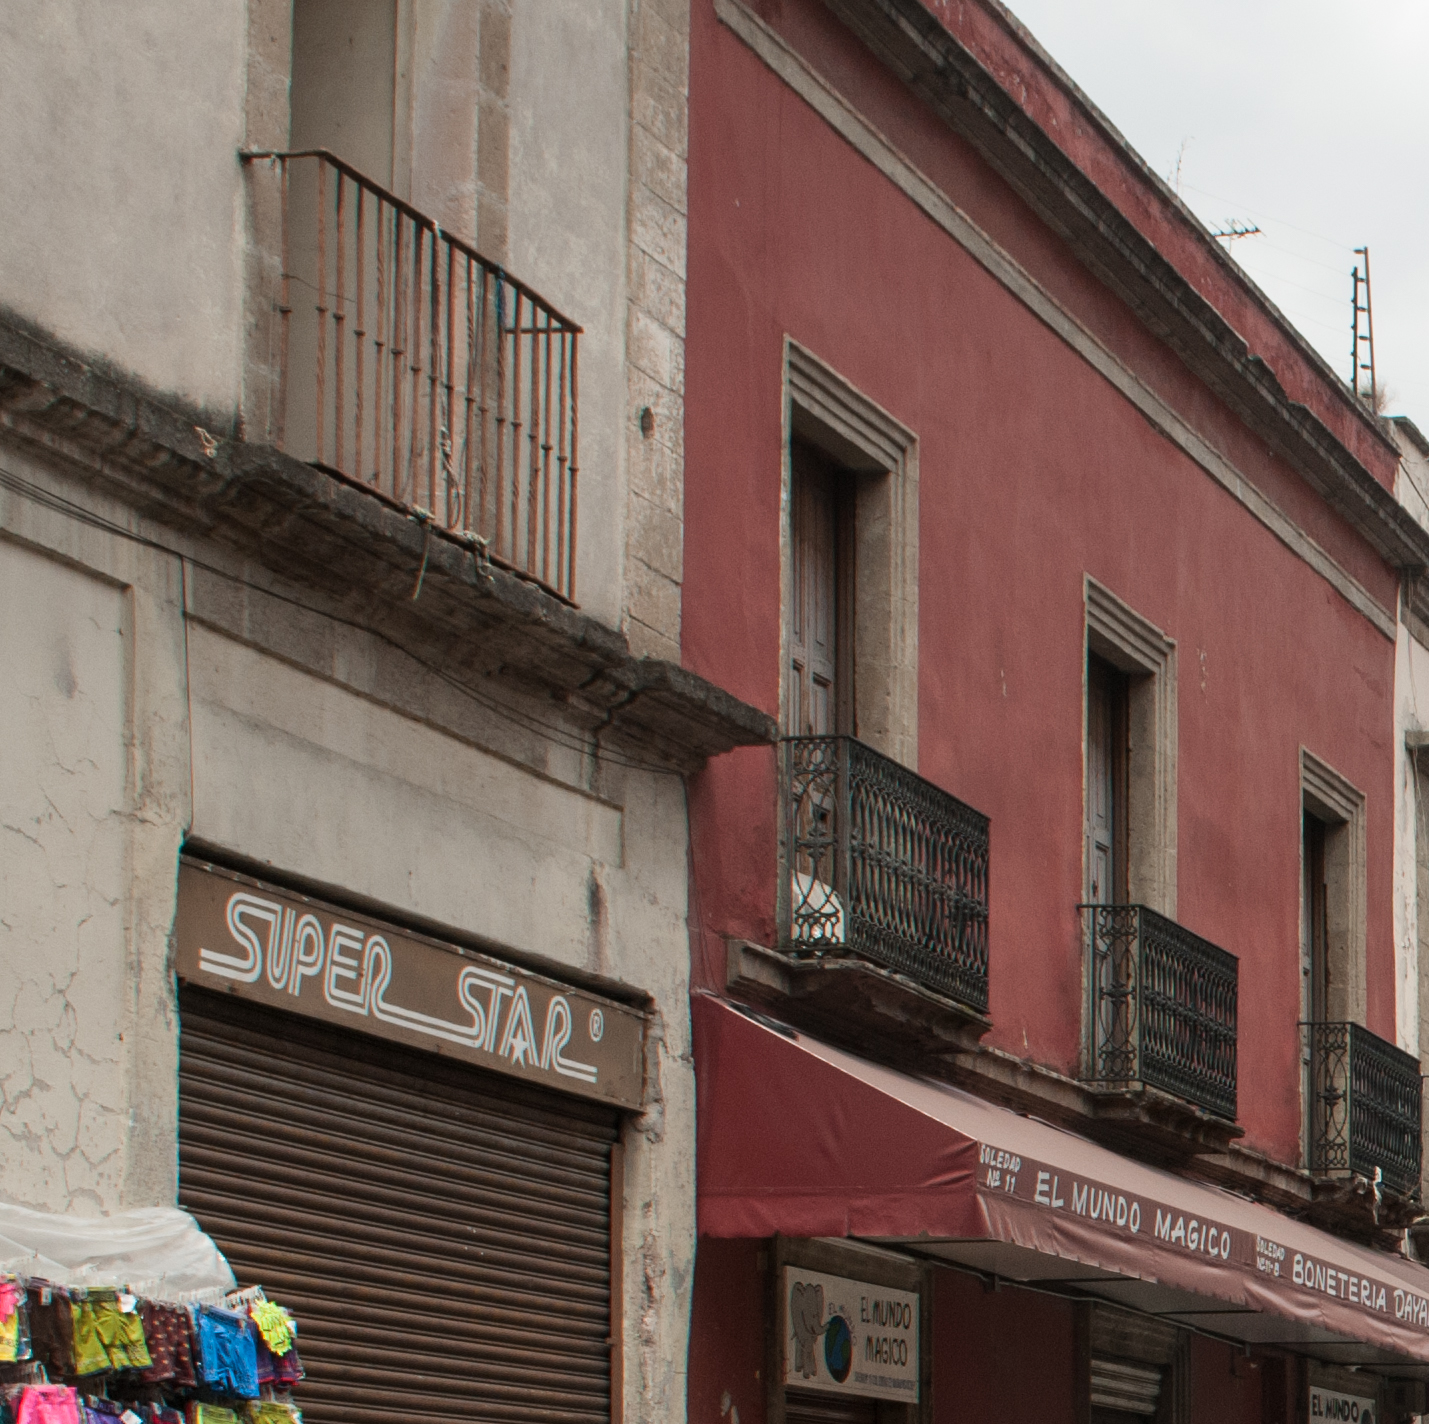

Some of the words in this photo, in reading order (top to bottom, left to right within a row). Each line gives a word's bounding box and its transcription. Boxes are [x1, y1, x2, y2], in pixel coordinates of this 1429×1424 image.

[199, 891, 420, 1022] SUPER
[458, 965, 598, 1084] STAR
[979, 1144, 1021, 1173] SOLEDAD
[1034, 1170, 1064, 1208] EL
[1072, 1181, 1141, 1234] MUNDO
[1155, 1208, 1231, 1260] MAGICO
[1256, 1235, 1286, 1261] SOLEDAD
[1292, 1253, 1387, 1312] BONETERIA
[861, 1297, 871, 1323] EL
[873, 1300, 912, 1330] MUNDO
[866, 1335, 908, 1367] MAGICO
[1311, 1394, 1323, 1417] EL
[1325, 1397, 1359, 1423] MUNDO
